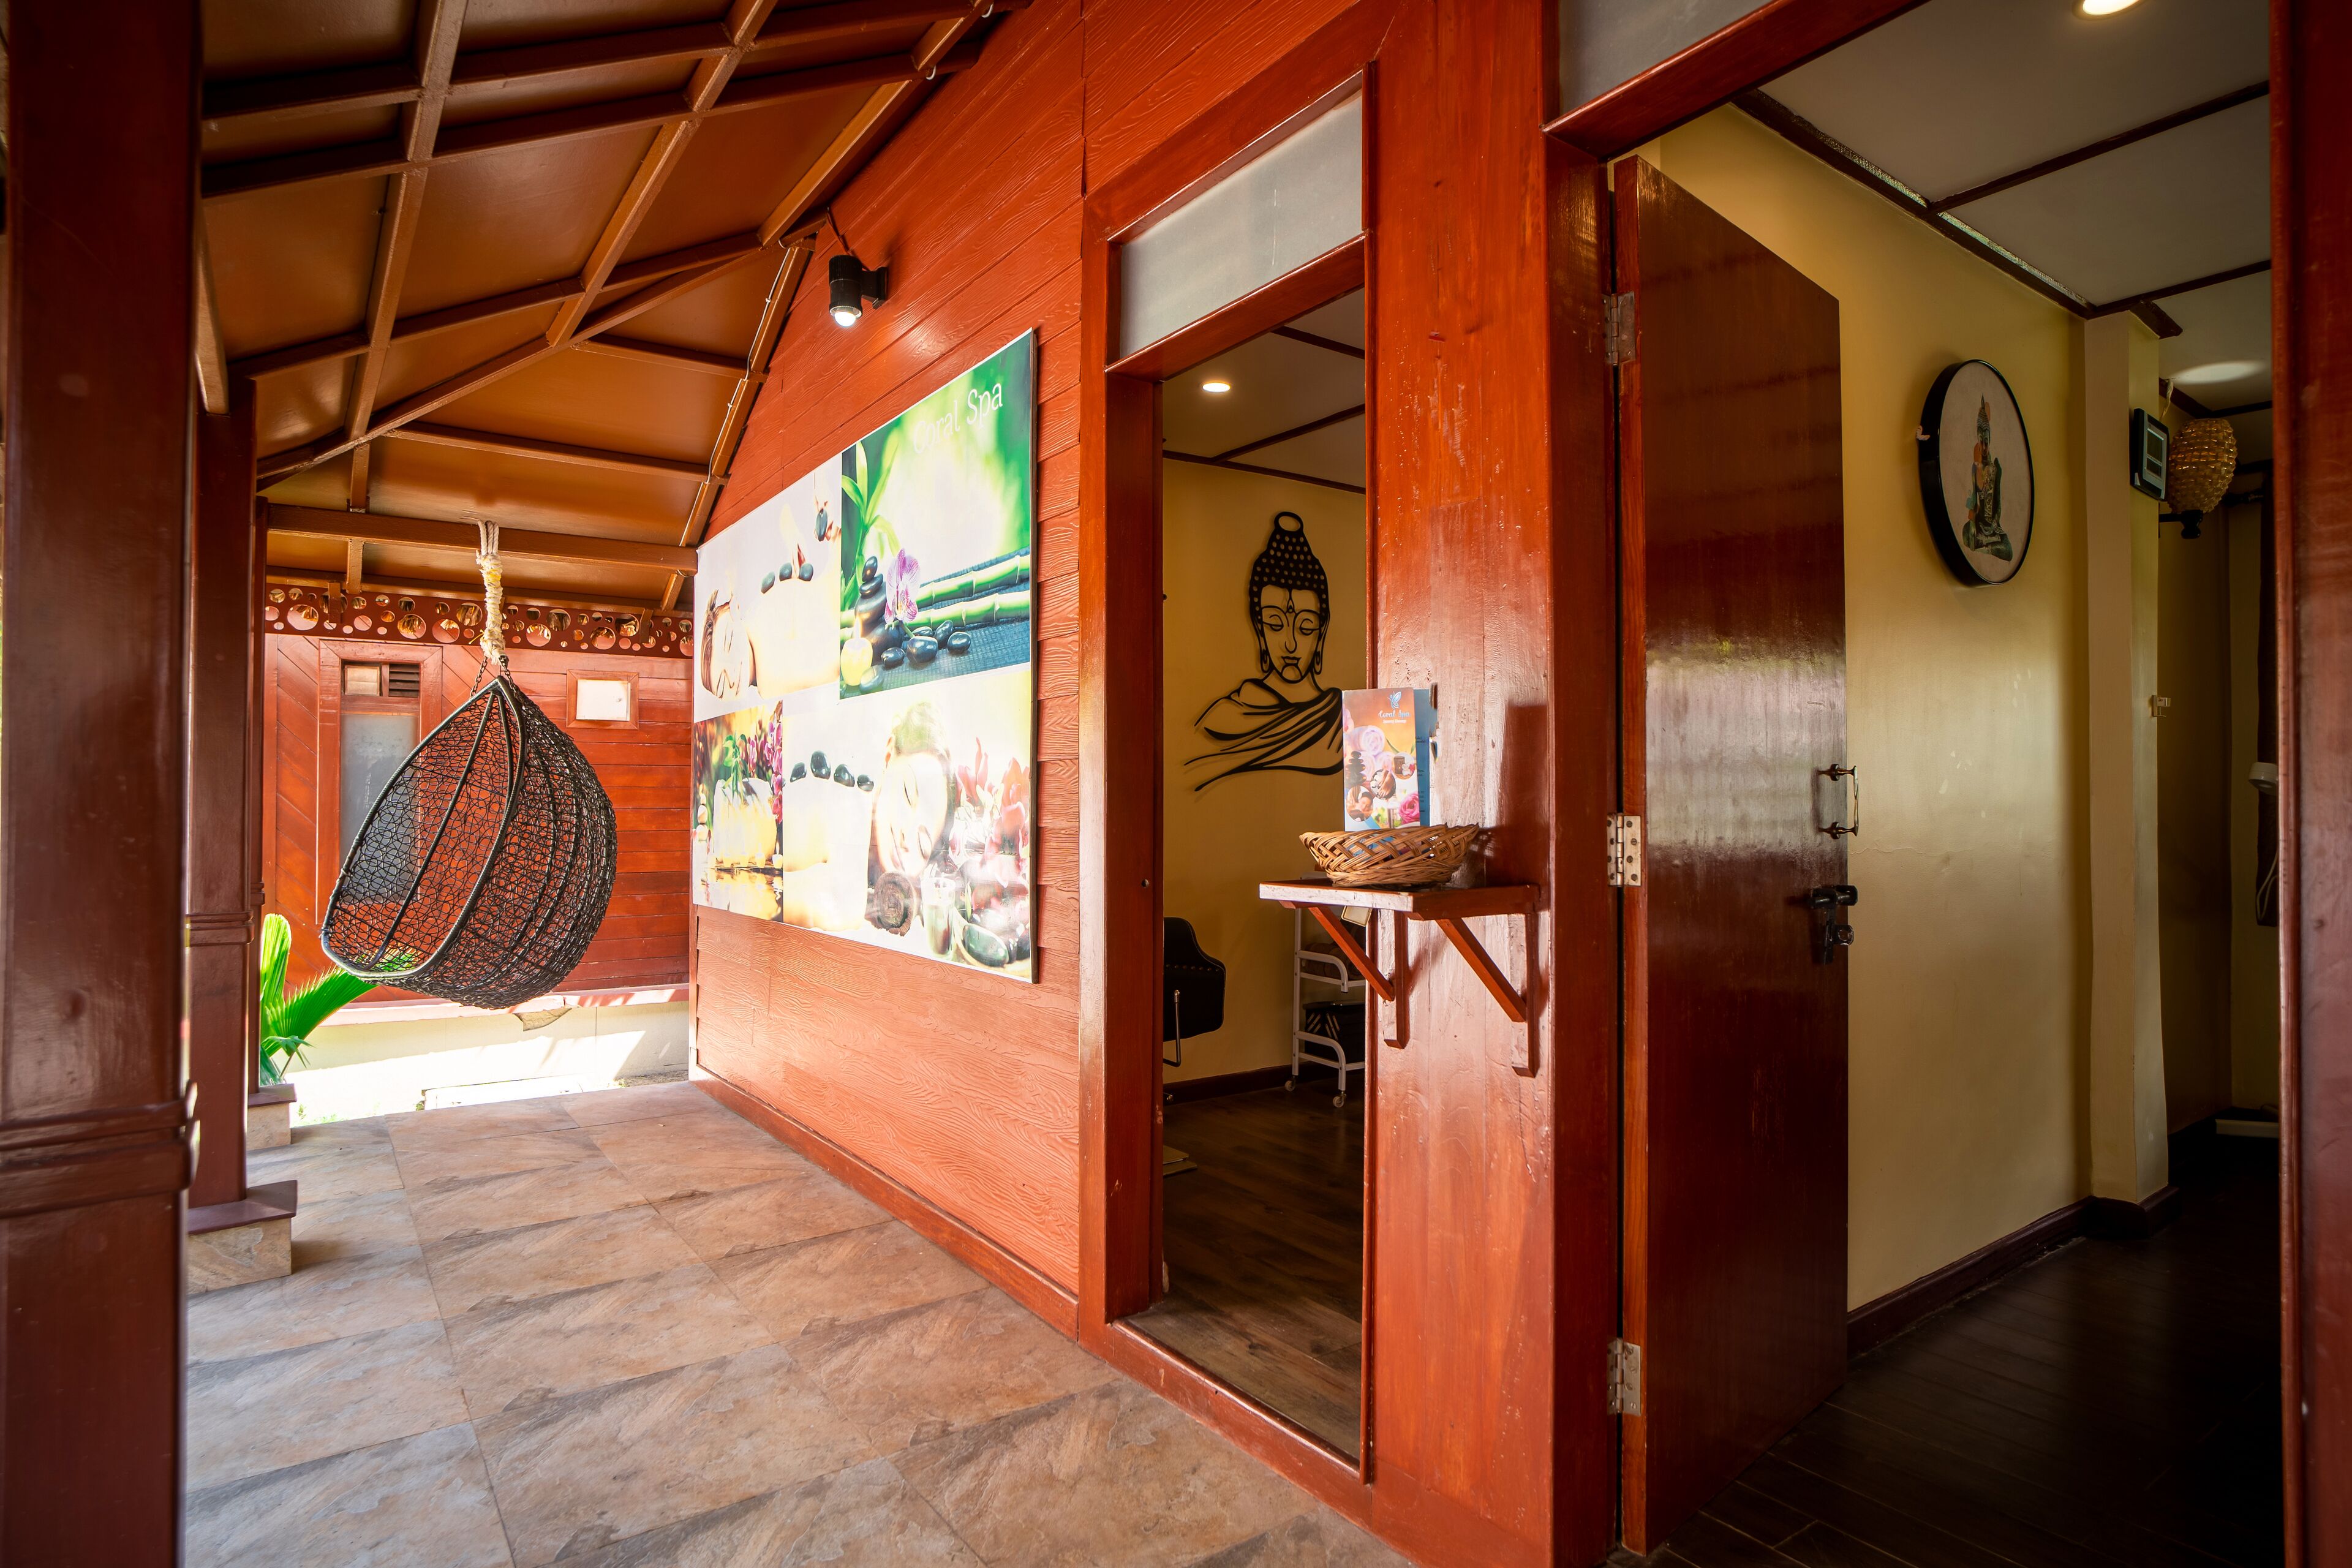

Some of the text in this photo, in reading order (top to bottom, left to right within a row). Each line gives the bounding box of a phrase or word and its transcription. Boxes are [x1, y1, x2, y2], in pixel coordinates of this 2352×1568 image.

[913, 383, 1003, 454] Coral Spa
[1378, 709, 1411, 719] Coral Spa
